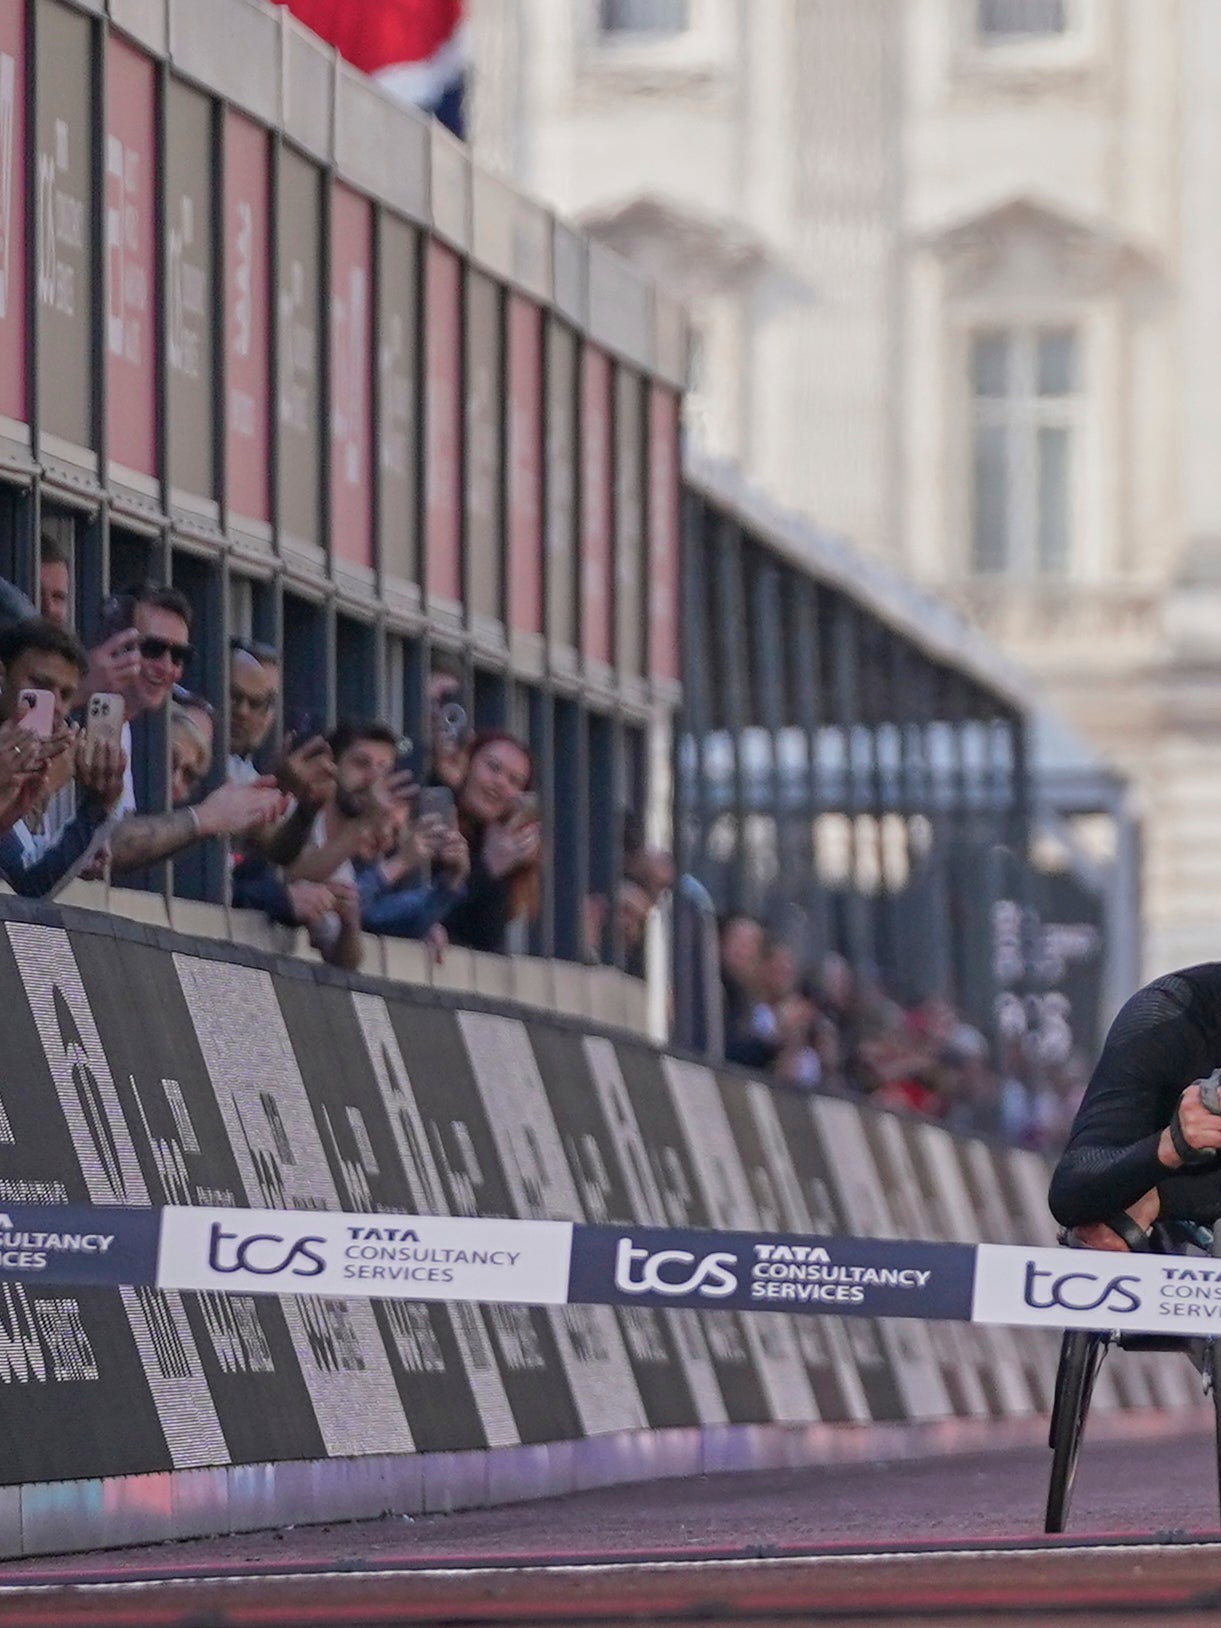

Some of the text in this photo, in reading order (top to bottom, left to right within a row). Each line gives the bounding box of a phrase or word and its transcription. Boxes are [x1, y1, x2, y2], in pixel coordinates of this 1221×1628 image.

[0, 1231, 115, 1250] ULTANCY
[346, 1226, 421, 1243] TATA
[208, 1220, 328, 1277] tcs
[344, 1244, 522, 1266] CONSULTANCY
[752, 1243, 831, 1263] TATA
[343, 1263, 455, 1283] SERVICES
[614, 1237, 738, 1297] tcs
[751, 1262, 932, 1287] CONSULTANCY
[751, 1280, 865, 1302] SERVICES
[1024, 1259, 1142, 1313] tcs
